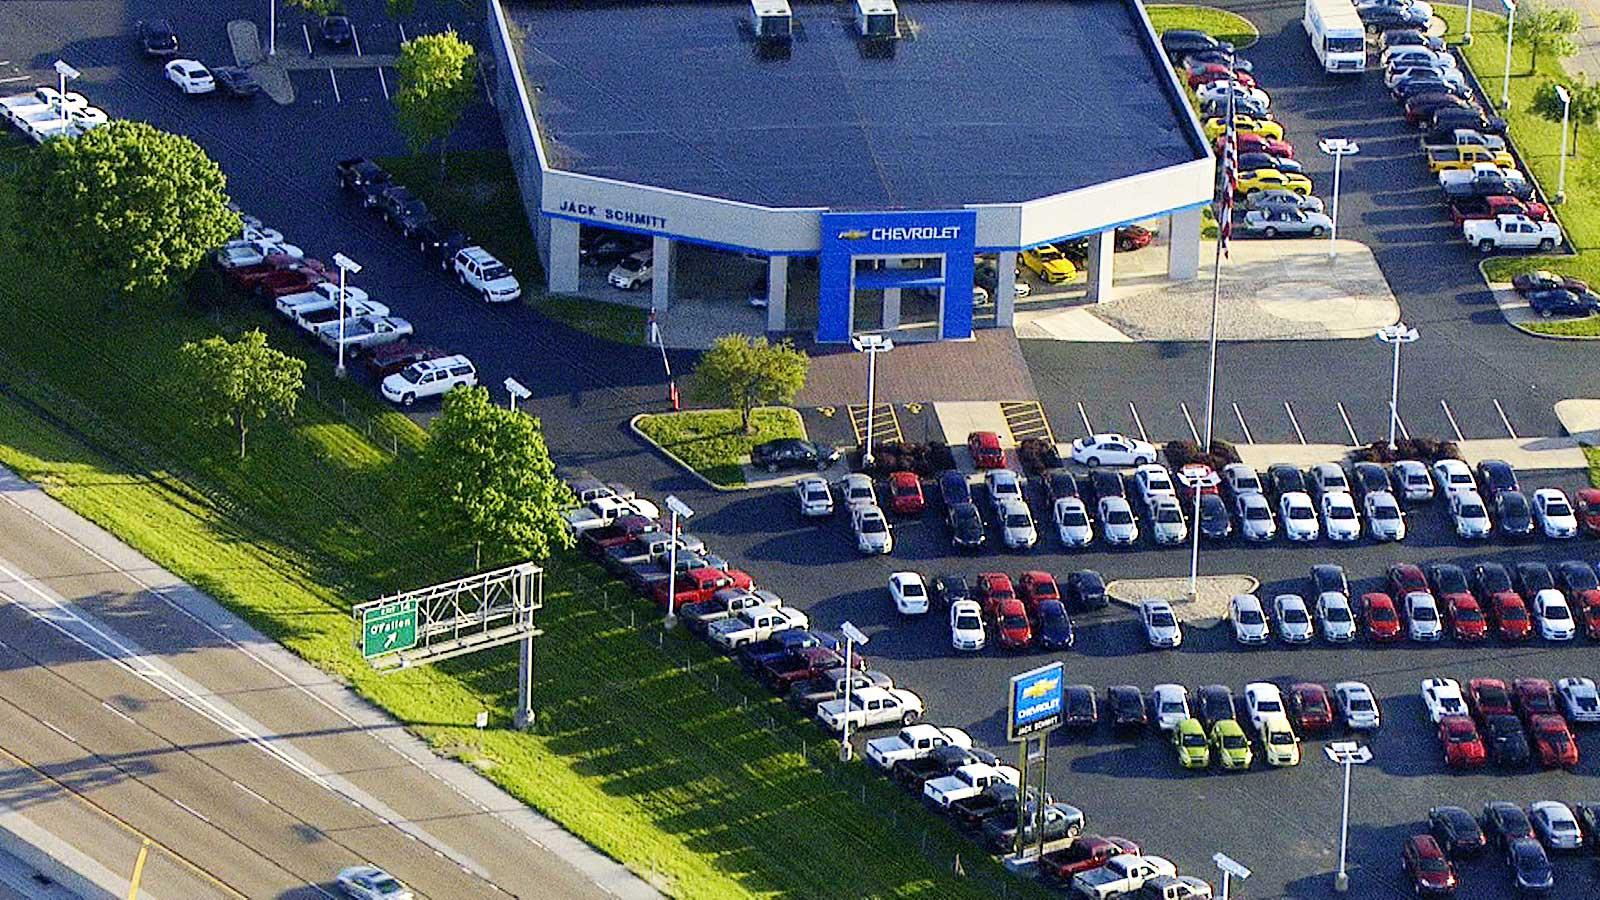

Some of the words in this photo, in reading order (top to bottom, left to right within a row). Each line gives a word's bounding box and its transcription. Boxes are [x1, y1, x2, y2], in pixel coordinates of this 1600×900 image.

[560, 202, 597, 215] JACK
[605, 208, 666, 228] SCHMITT
[871, 227, 960, 240] CHEVROLET
[1018, 698, 1059, 719] CHEVROLET
[1018, 725, 1032, 736] JACK
[1034, 715, 1058, 731] SCHMITT
